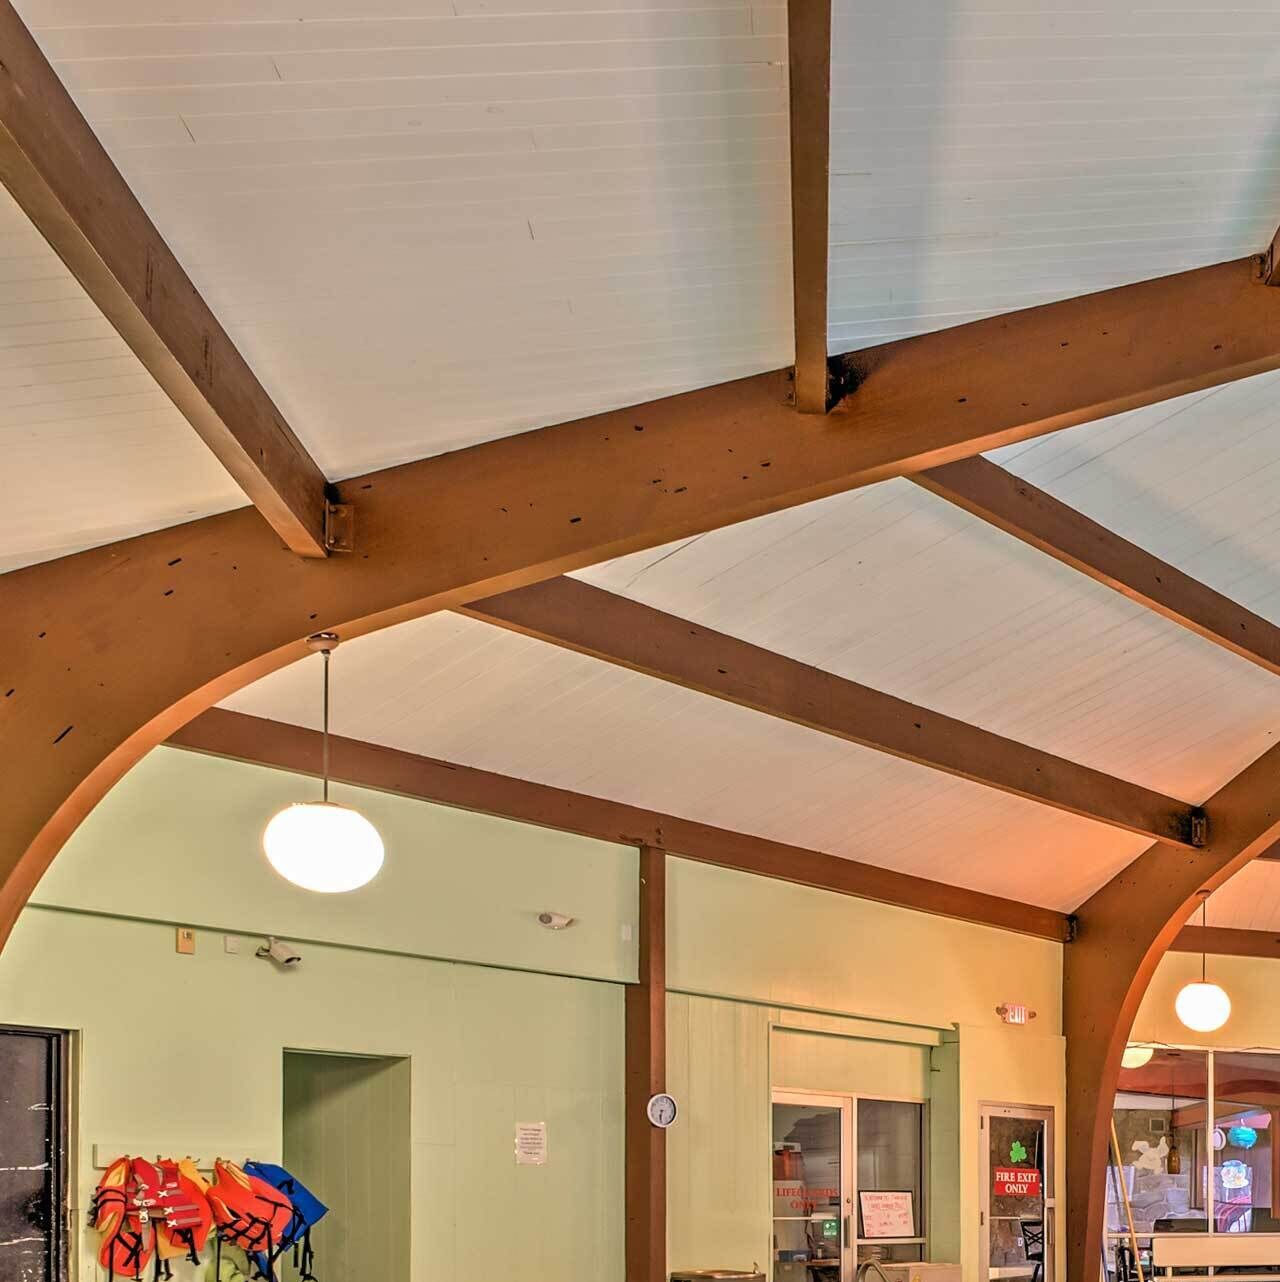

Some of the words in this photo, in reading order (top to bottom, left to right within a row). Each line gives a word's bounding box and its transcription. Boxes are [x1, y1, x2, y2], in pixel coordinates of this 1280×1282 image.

[996, 1172, 1016, 1182] FIRE
[1017, 1172, 1038, 1183] EXIT
[1005, 1183, 1029, 1194] ONLY
[790, 1200, 818, 1210] ONLY
